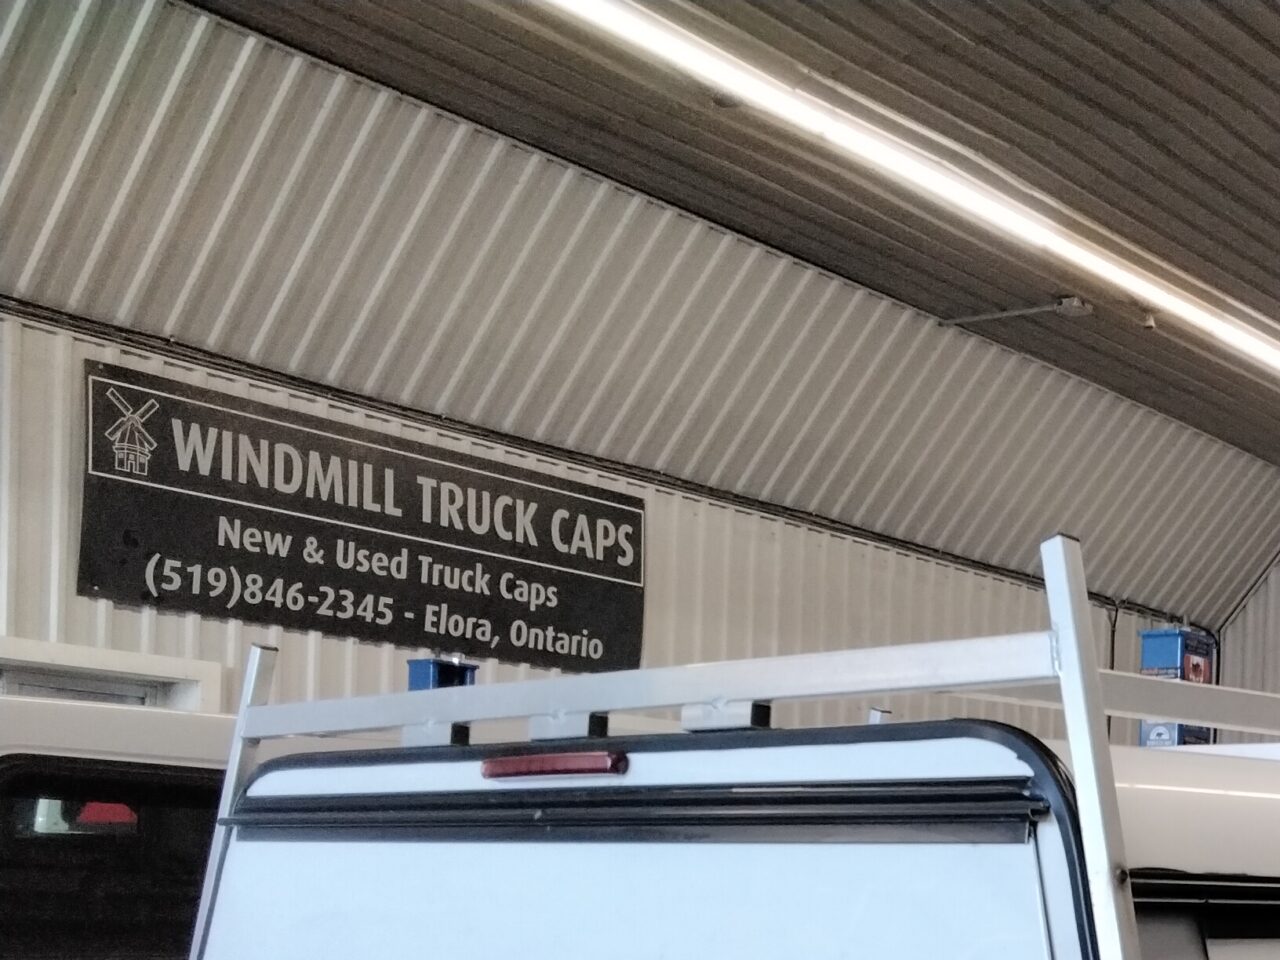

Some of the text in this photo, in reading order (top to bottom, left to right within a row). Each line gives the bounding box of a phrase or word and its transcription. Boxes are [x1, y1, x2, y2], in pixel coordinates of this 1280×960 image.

[171, 418, 634, 567] WINDMILL TRUCK CAPS
[144, 552, 394, 625] (519)846-2345
[424, 603, 499, 649] Elora,
[510, 619, 604, 660] Ontario
[217, 516, 558, 611] New & Used Truck Caps
